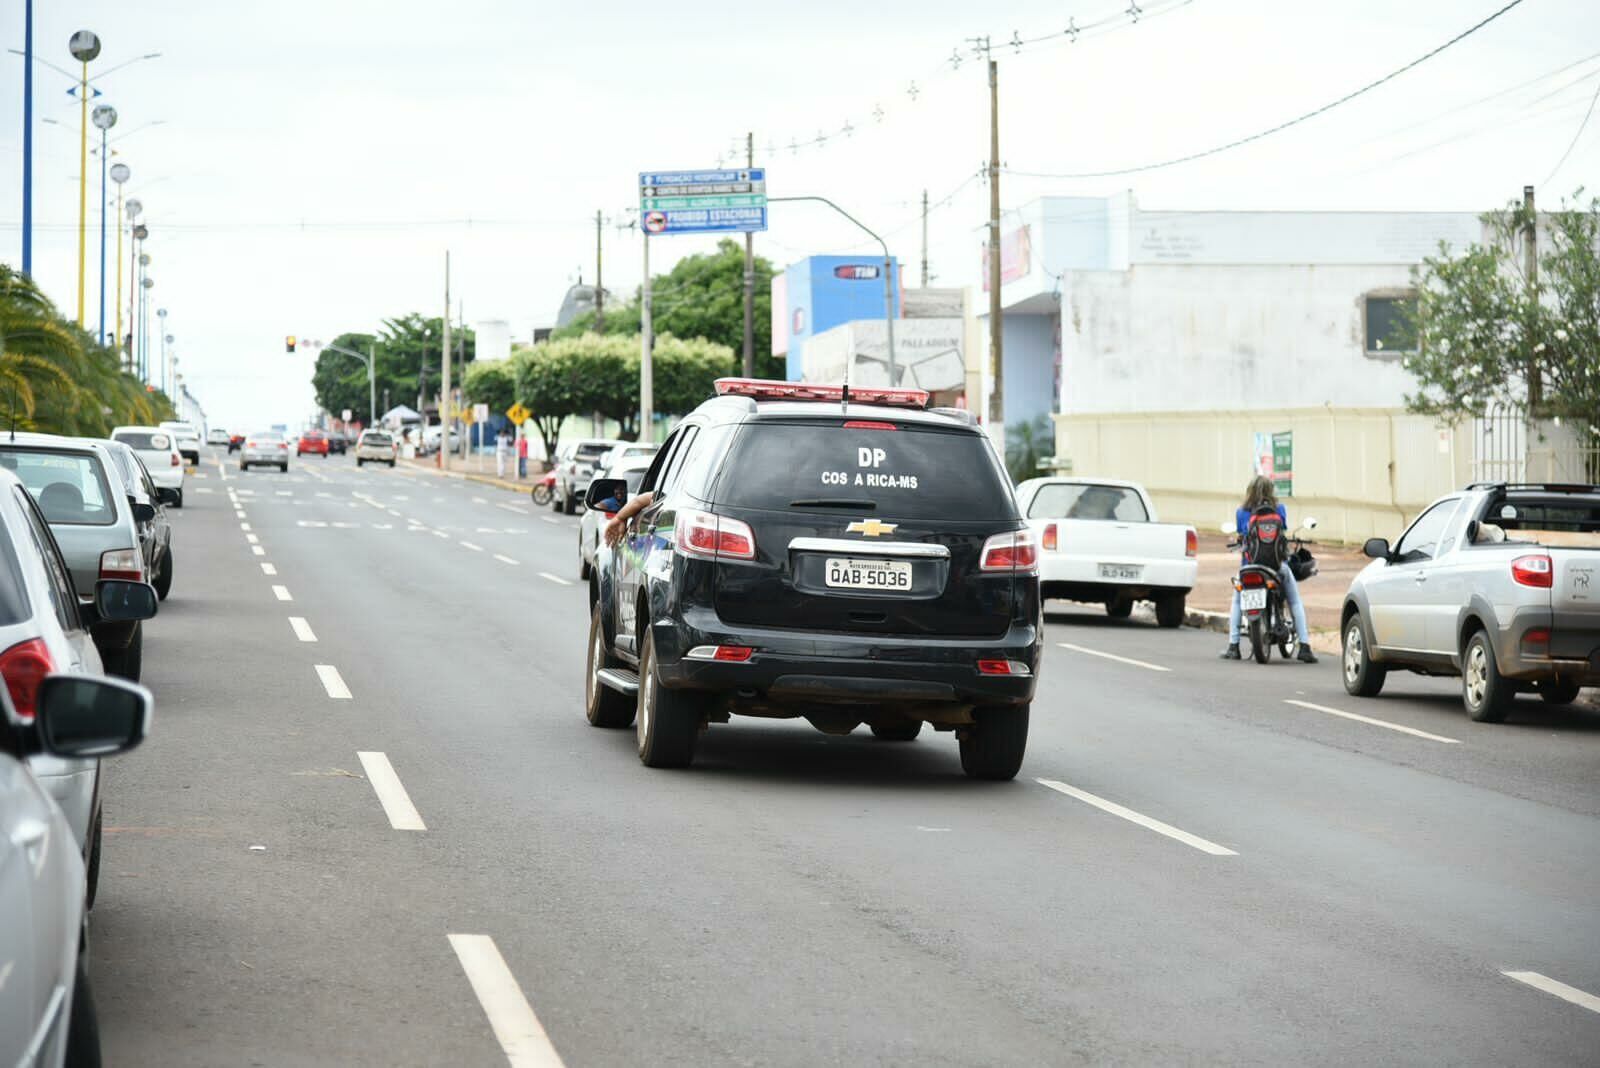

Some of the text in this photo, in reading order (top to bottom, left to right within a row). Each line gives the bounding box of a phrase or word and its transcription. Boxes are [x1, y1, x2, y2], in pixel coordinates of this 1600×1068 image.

[855, 266, 877, 279] TIM
[902, 338, 959, 350] PALLADIUM
[858, 446, 886, 468] DP
[821, 471, 848, 485] COS
[867, 473, 918, 489] RICA-MS
